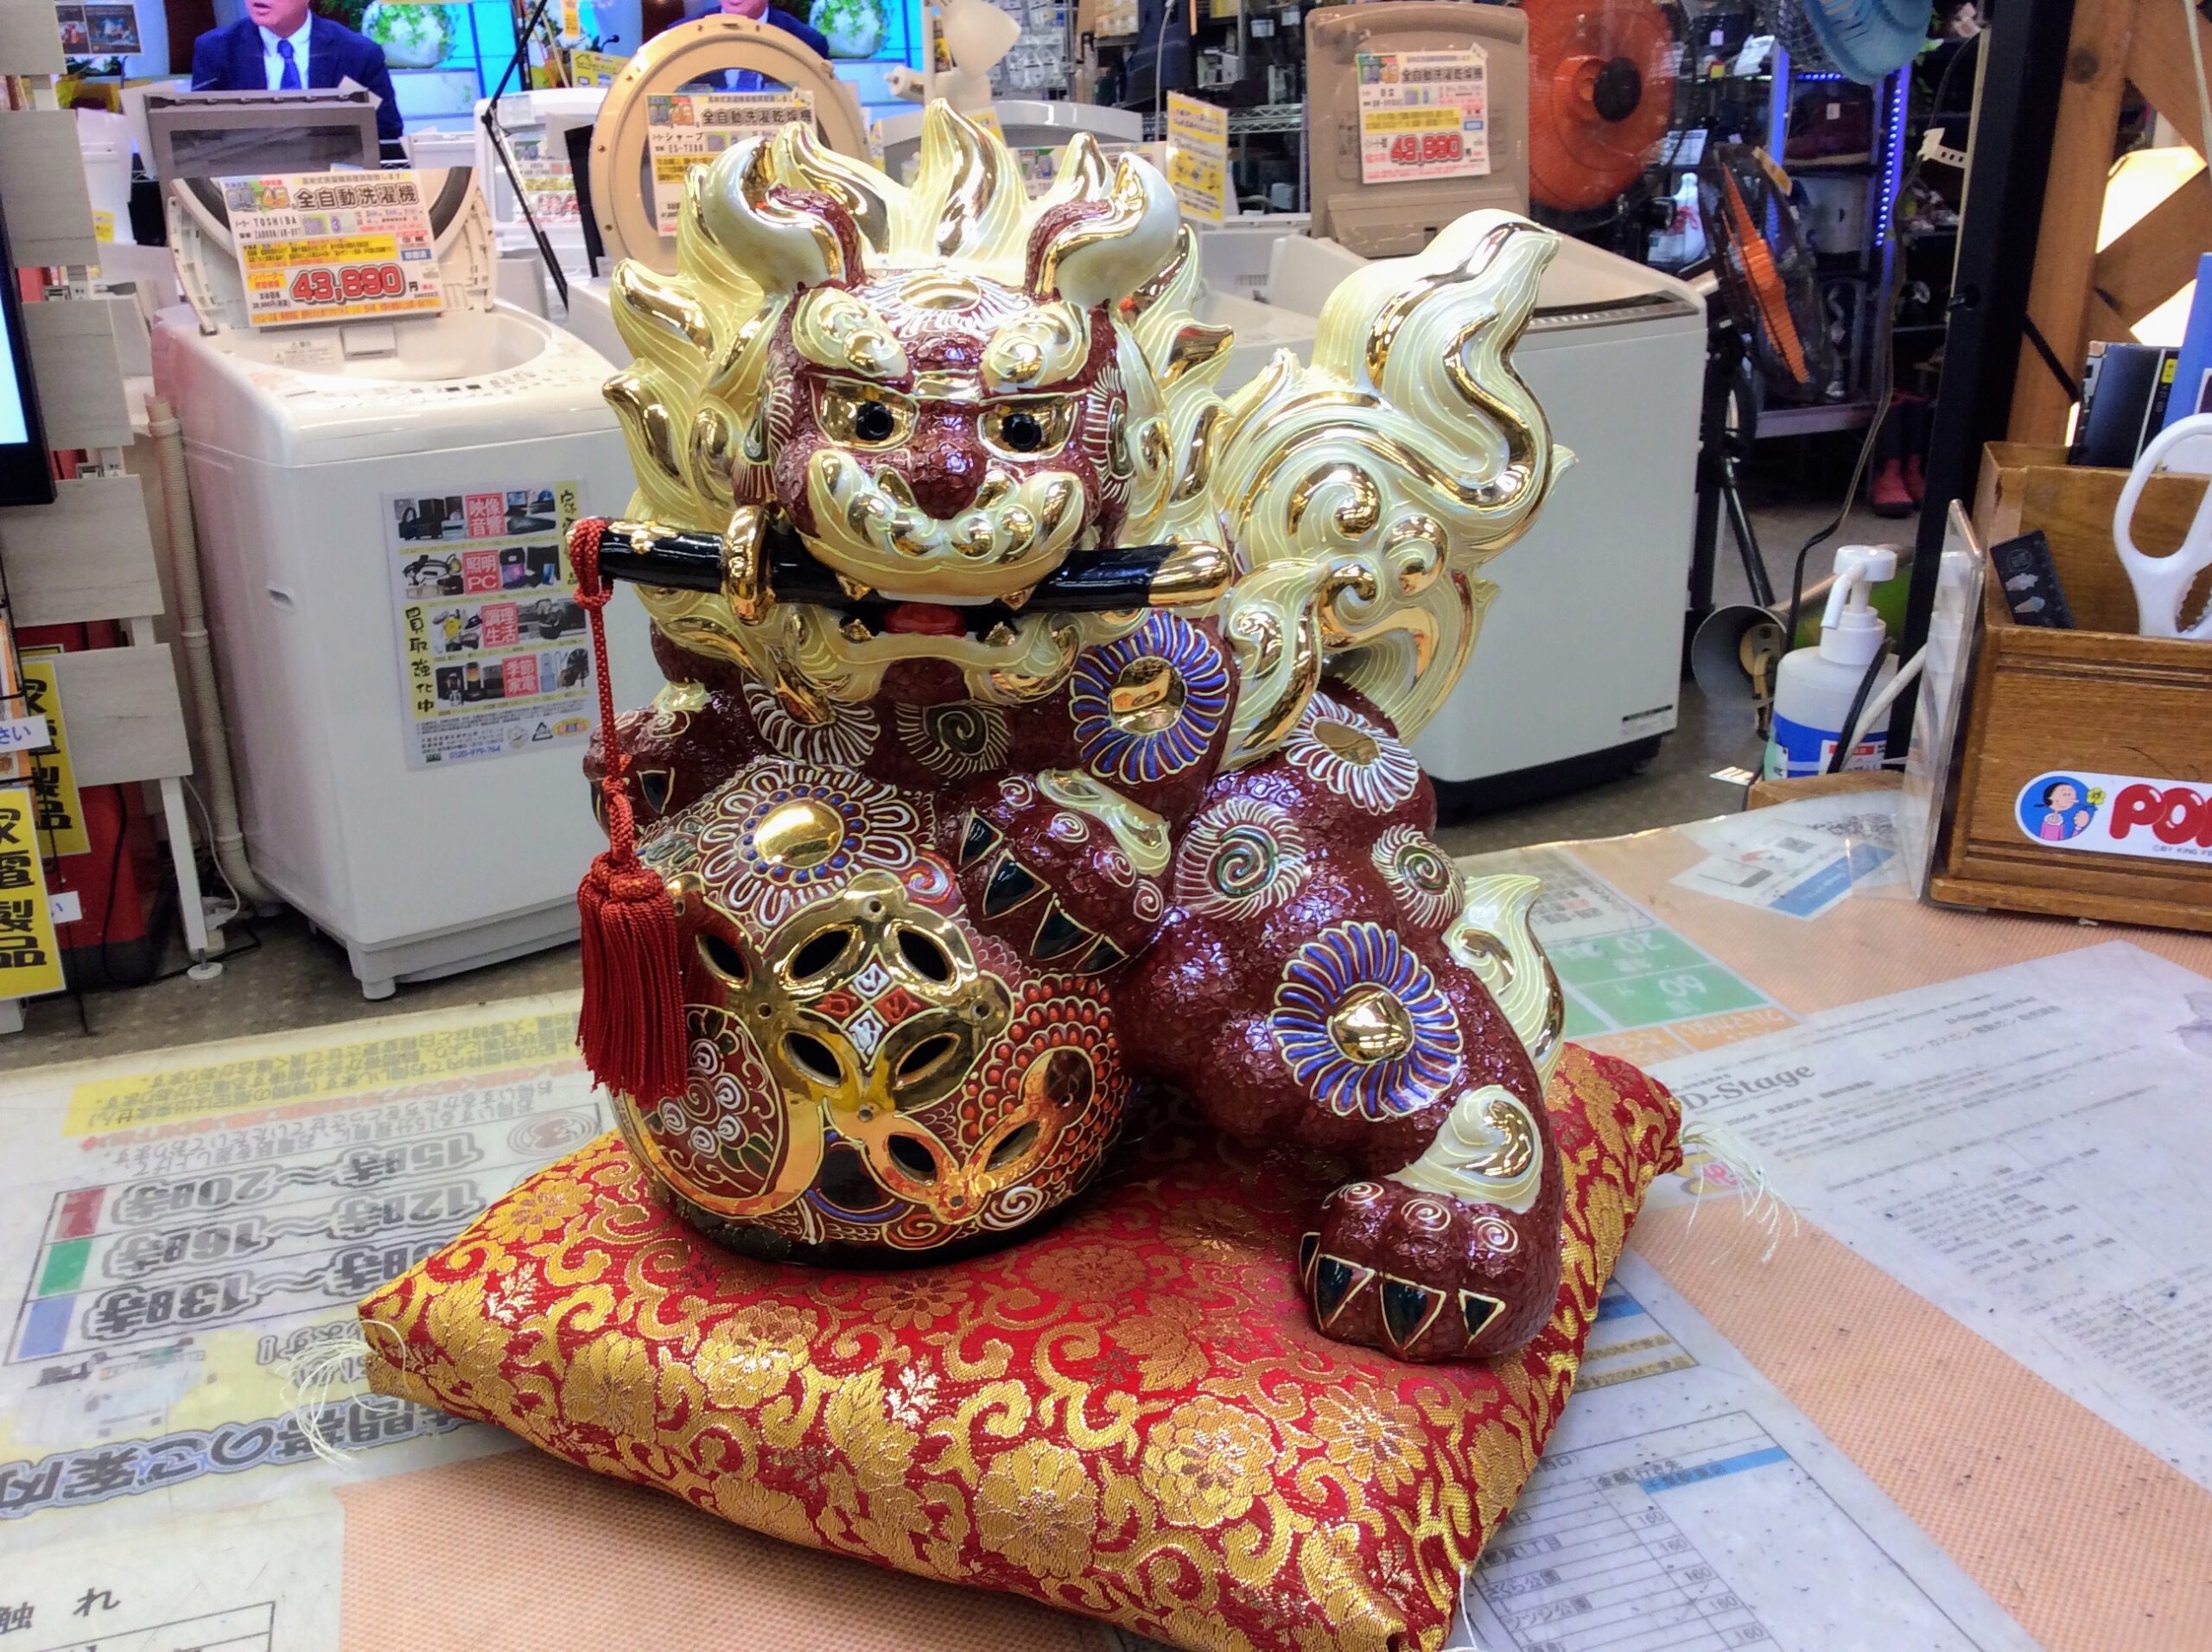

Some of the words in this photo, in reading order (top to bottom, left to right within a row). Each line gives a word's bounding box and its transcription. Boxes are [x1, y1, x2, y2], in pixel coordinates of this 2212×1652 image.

[296, 183, 418, 208] 全自動洗濯機
[254, 217, 296, 226] TOSHIBA
[292, 264, 403, 302] 43,890
[409, 281, 419, 291] 円
[469, 499, 501, 518] 映像
[467, 556, 497, 573] 照明
[467, 575, 497, 589] PC
[486, 626, 516, 645] 生活
[405, 607, 435, 713] 買取強化中
[2176, 847, 2198, 855] KING
[1681, 1064, 1815, 1110] D-Stage
[1637, 1512, 1664, 1526] 160
[1659, 1537, 1686, 1554] 160
[1684, 1565, 1713, 1583] 160
[1709, 1597, 1738, 1612] 160
[1734, 1625, 1765, 1642] 160
